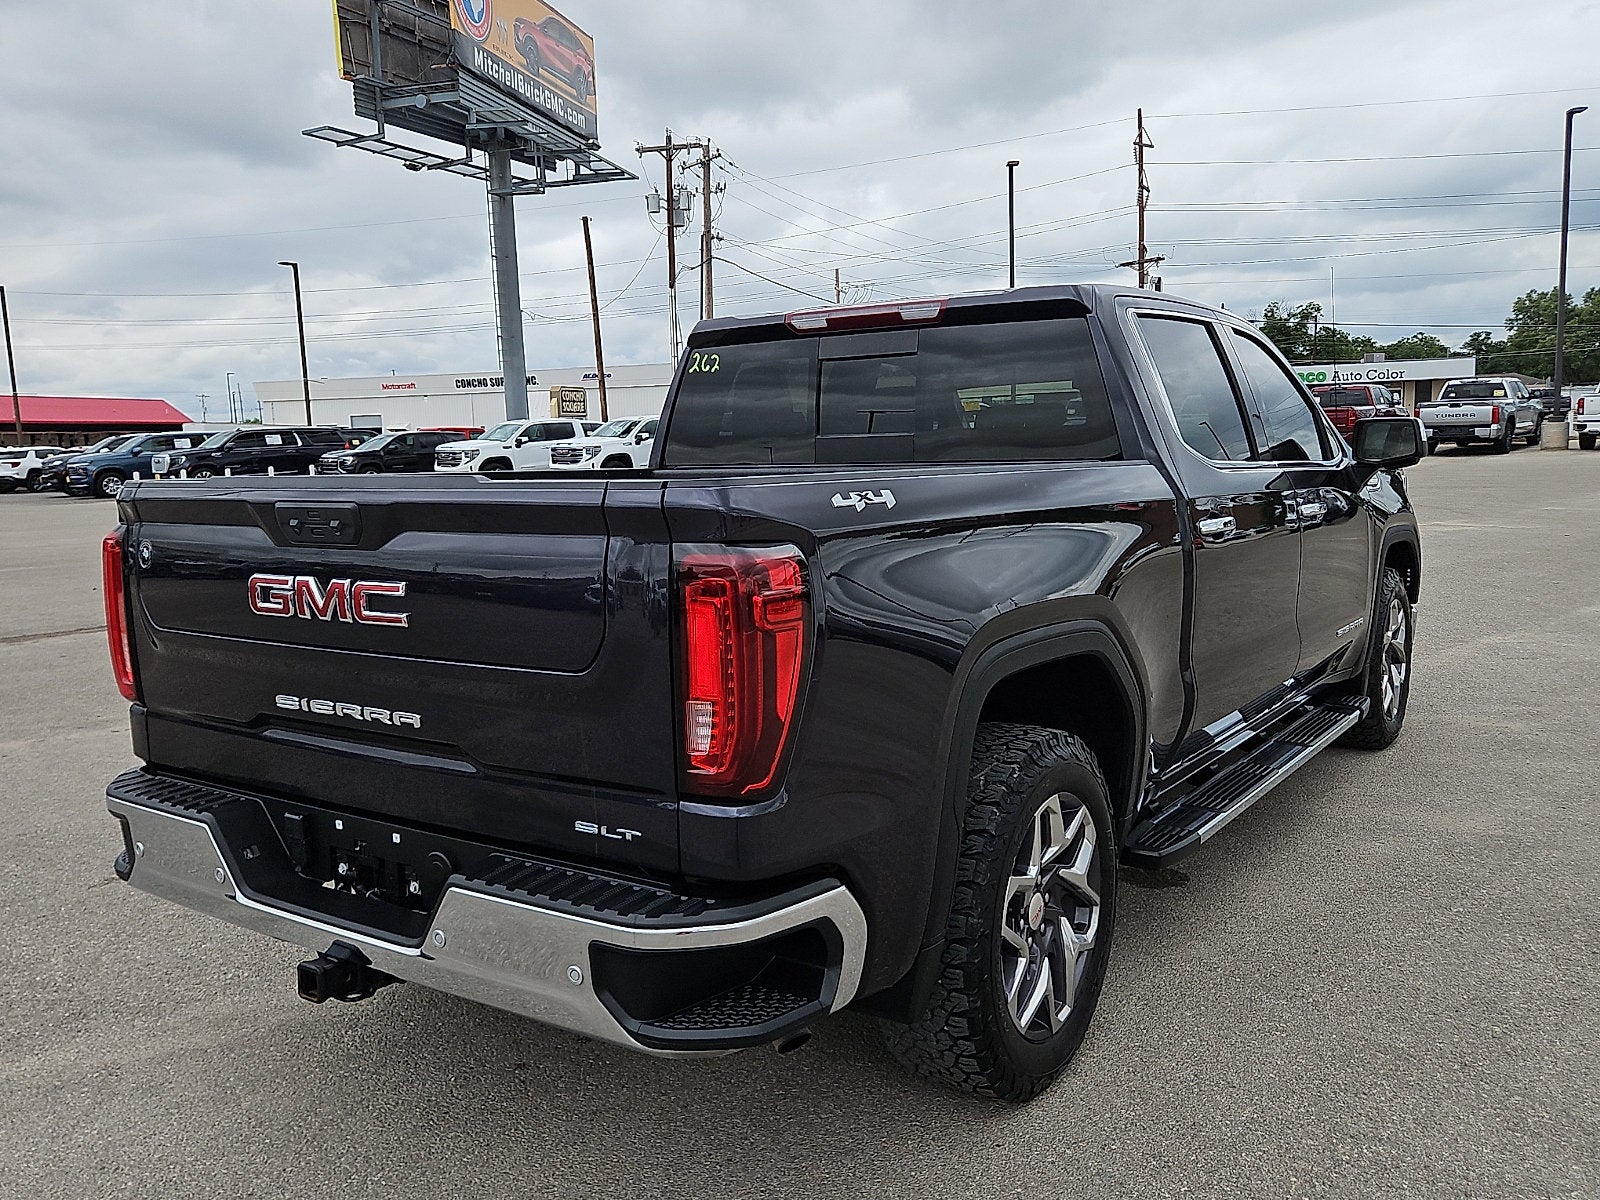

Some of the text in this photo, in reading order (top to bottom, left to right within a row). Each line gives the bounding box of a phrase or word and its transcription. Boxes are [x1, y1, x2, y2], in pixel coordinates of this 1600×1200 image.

[474, 46, 586, 129] MitchellBuickGMC.com
[688, 352, 720, 373] 262
[455, 377, 488, 389] CONCHO
[1331, 370, 1363, 381] Auto
[1366, 368, 1406, 380] Color
[381, 382, 417, 390] Motorcraft
[562, 391, 584, 402] CONCHO
[248, 573, 412, 628] GMC
[275, 694, 422, 729] SIERRA
[574, 820, 642, 841] SLT
